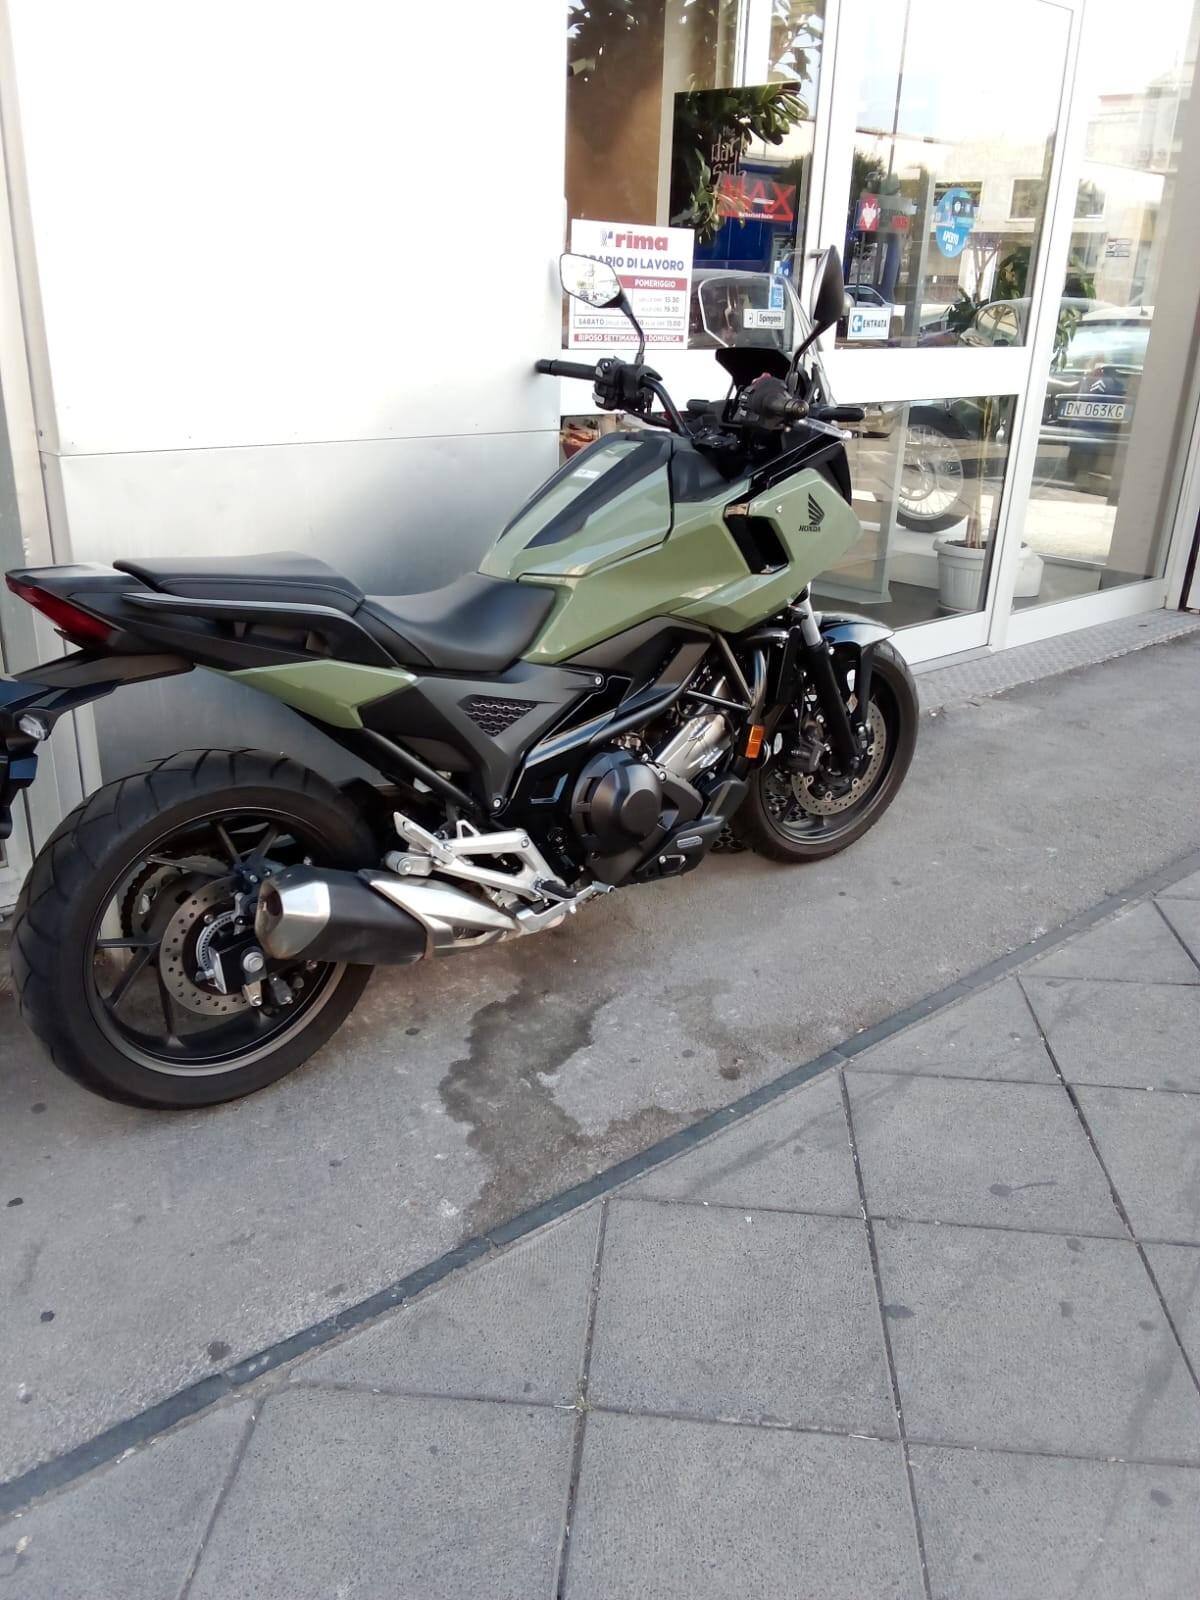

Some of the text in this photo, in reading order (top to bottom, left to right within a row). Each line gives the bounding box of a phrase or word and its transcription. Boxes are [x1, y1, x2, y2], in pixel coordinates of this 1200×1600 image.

[627, 257, 638, 269] DI
[640, 258, 685, 271] LAVORO
[634, 279, 677, 289] POMERIGGIO
[863, 319, 887, 328] ENTRATA
[1066, 402, 1081, 415] DN
[798, 524, 821, 532] HONDA
